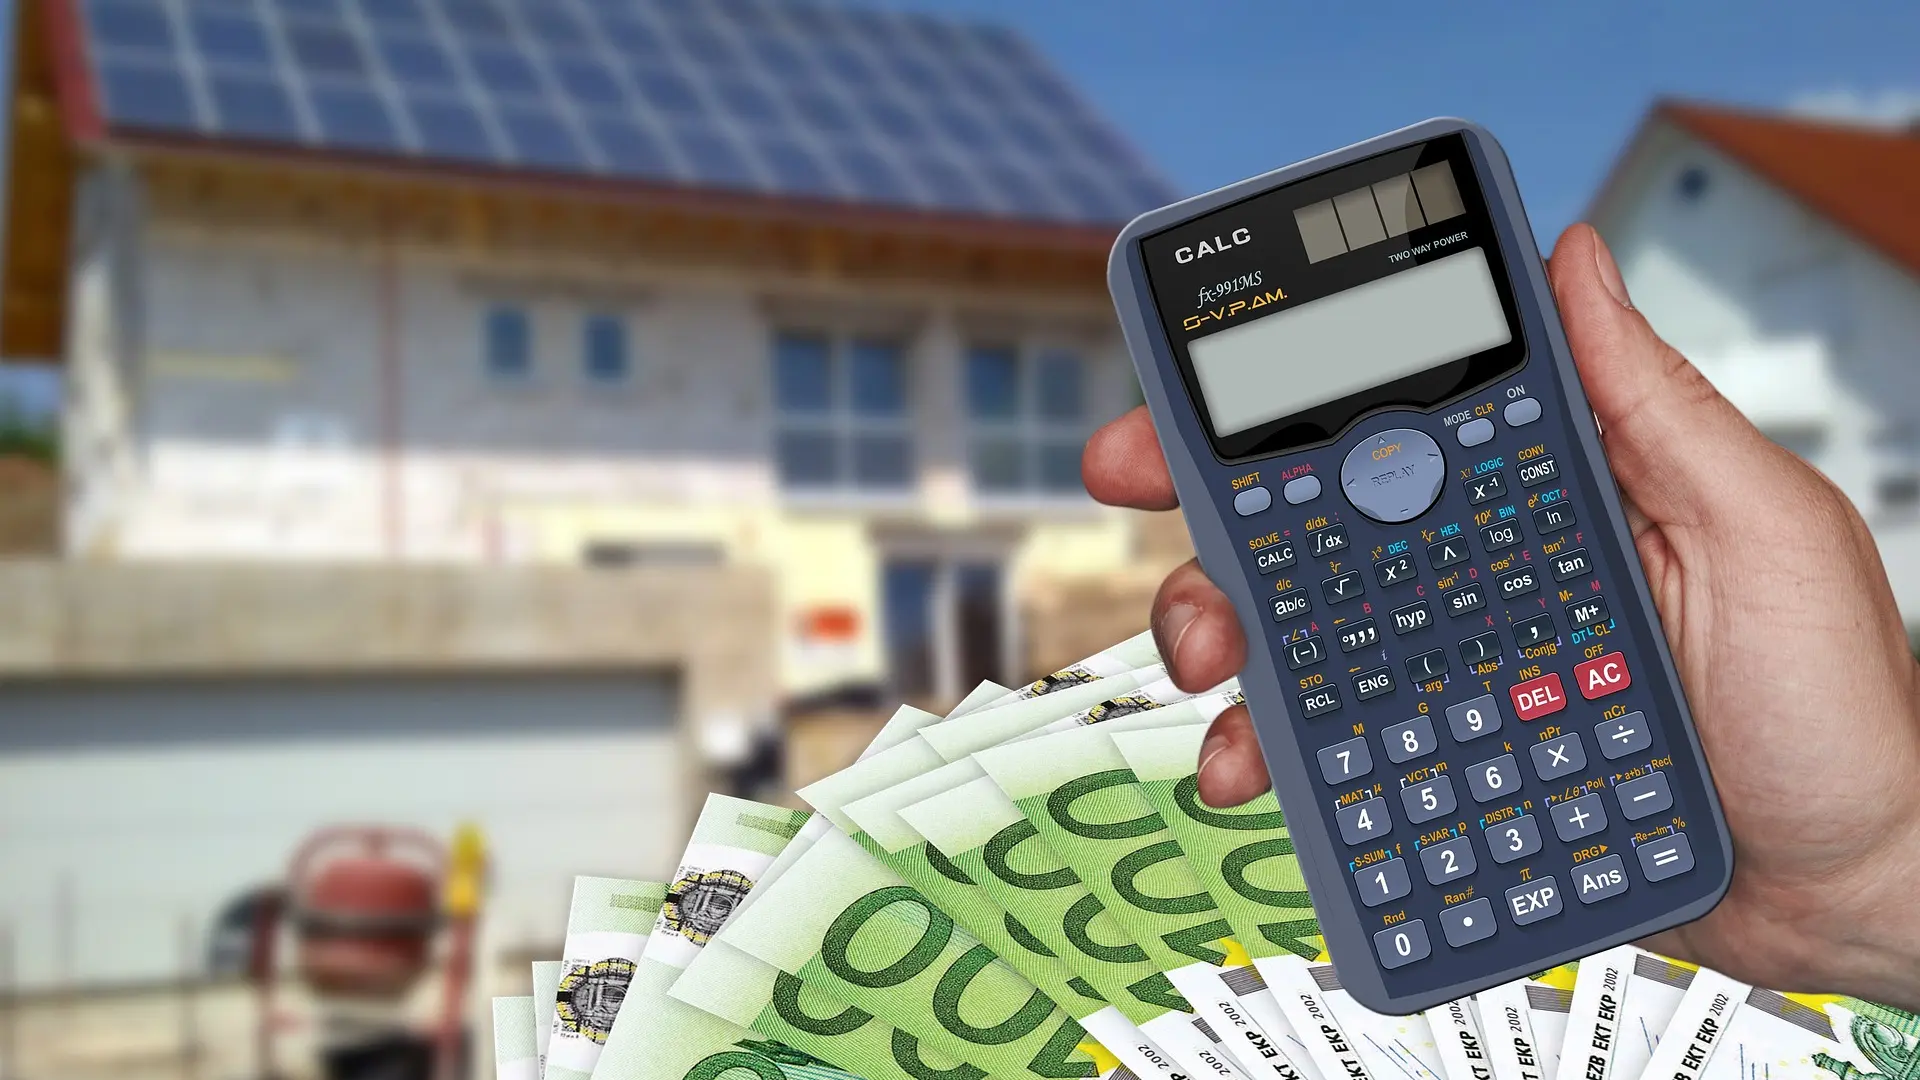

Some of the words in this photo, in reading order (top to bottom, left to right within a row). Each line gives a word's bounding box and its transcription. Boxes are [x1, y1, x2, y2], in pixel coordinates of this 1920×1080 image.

[1174, 227, 1251, 264] CALC
[1388, 250, 1410, 263] TWO
[1411, 243, 1431, 256] WAY
[1433, 231, 1469, 249] POWER
[1197, 270, 1262, 309] fx-991MS
[1506, 385, 1526, 399] ON
[1443, 410, 1472, 427] MODE
[1474, 402, 1495, 417] CLR
[1372, 443, 1402, 461] COPY
[1518, 444, 1545, 461] CONV
[1282, 463, 1313, 480] ALPHA
[1474, 457, 1504, 475] LOGIC
[1520, 460, 1556, 482] CONST
[1231, 471, 1261, 490] SHIFT
[1371, 464, 1415, 488] REPLAY
[1541, 489, 1561, 503] OCT
[1498, 505, 1516, 518] BIN
[1305, 516, 1328, 531] d/dx
[1440, 523, 1461, 537] HEX
[1248, 532, 1280, 550] SOLVE
[1489, 527, 1514, 544] log
[1576, 532, 1583, 544] F
[1387, 540, 1409, 554] DEC
[1522, 550, 1531, 561] E
[1258, 548, 1293, 568] CALC
[1558, 557, 1585, 574] tan
[1469, 568, 1478, 579] D
[1503, 574, 1533, 592] cos
[1276, 579, 1293, 592] d/c
[1416, 585, 1425, 596] C
[1591, 580, 1601, 592] M
[1275, 597, 1306, 615] ab/c
[1363, 602, 1372, 614] B
[1452, 592, 1478, 609] sin
[1395, 609, 1426, 628] hyp
[1574, 604, 1599, 623] M+
[1311, 621, 1319, 632] A
[1525, 642, 1557, 660] Conjg
[1584, 643, 1604, 659] OFF
[1477, 661, 1499, 676] Abs
[1519, 665, 1541, 681] INS
[1588, 662, 1621, 691] AC
[1300, 673, 1323, 689] STO
[1358, 674, 1389, 694] ENG
[1425, 680, 1443, 693] arg
[1483, 680, 1492, 692] T
[1305, 693, 1335, 712] RCL
[1418, 702, 1429, 714] G
[1517, 685, 1560, 712] DEL
[1466, 709, 1483, 732] 9
[1603, 705, 1626, 720] nCr
[1352, 722, 1365, 736] M
[1539, 725, 1561, 741] nPr
[1402, 730, 1419, 753] 8
[1336, 750, 1350, 775] 7
[1406, 767, 1430, 783] VCT
[1485, 766, 1503, 789] 6
[1340, 789, 1364, 805] MAT
[1421, 787, 1438, 811] 5
[1357, 808, 1374, 831] 4
[1485, 806, 1515, 824] DISTR
[1672, 816, 1686, 829] %
[1420, 828, 1450, 846] S-VAR
[1505, 828, 1523, 852] 3
[1354, 849, 1386, 868] S-SUM
[1440, 850, 1459, 874] 2
[1375, 871, 1389, 894] 1
[1583, 869, 1622, 894] Ans
[1444, 885, 1474, 905] Ran#
[1512, 887, 1554, 916] EXP
[1383, 910, 1406, 925] Rnd
[1394, 933, 1411, 957] 0
[1603, 967, 1618, 991] 2002
[1218, 1001, 1246, 1027] 2002
[1300, 994, 1324, 1019] 2002
[1598, 994, 1617, 1022] EKP
[1505, 1007, 1522, 1033] 2002
[1320, 1025, 1350, 1053] EKP
[1592, 1023, 1612, 1051] EKT
[1681, 1043, 1707, 1071] EKT
[1695, 1017, 1719, 1044] EKP
[1709, 993, 1729, 1016] 2002
[1245, 1030, 1278, 1059] EKP
[1459, 1030, 1483, 1059] EKP
[1513, 1037, 1535, 1066] EKP
[1138, 1044, 1169, 1069] 2002
[1199, 1050, 1231, 1075] 2002
[1586, 1054, 1606, 1080] EZB
